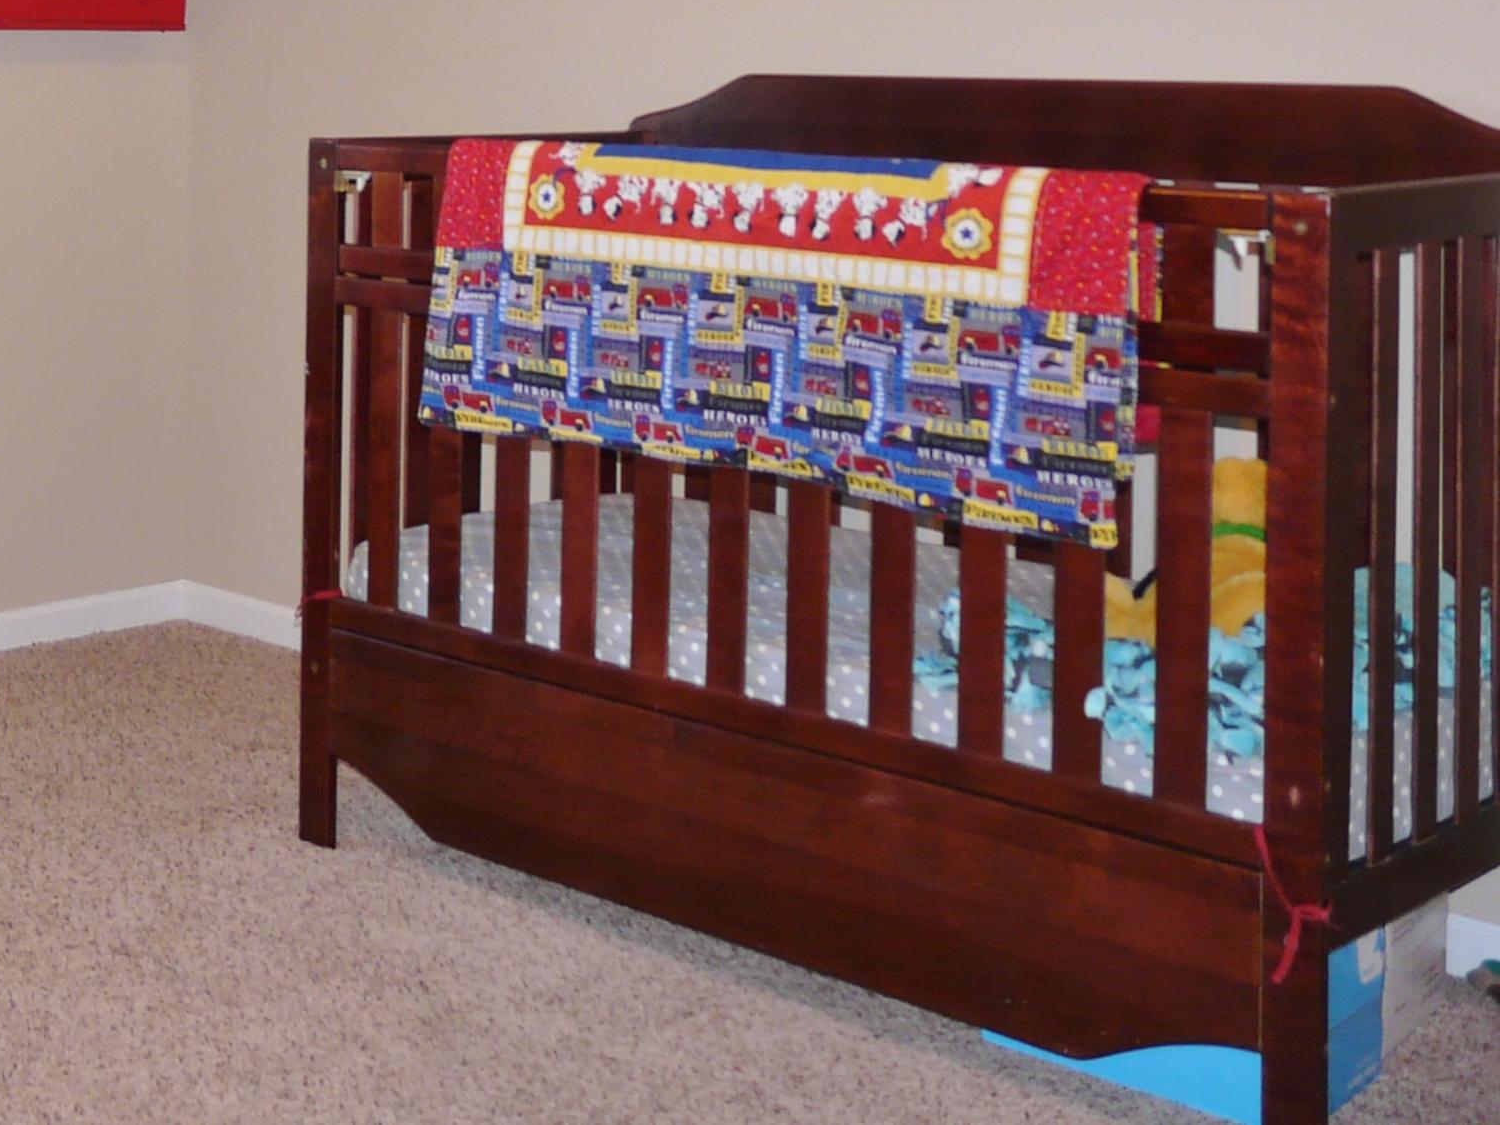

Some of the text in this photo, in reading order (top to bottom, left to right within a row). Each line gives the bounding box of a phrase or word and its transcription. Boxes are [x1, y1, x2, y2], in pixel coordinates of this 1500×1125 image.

[472, 316, 485, 381] Firemen
[568, 331, 578, 398] Firemen
[661, 341, 674, 410] Firemen
[769, 353, 784, 424] Firemen
[866, 371, 885, 443] Firemen
[988, 389, 1006, 466] Firemen
